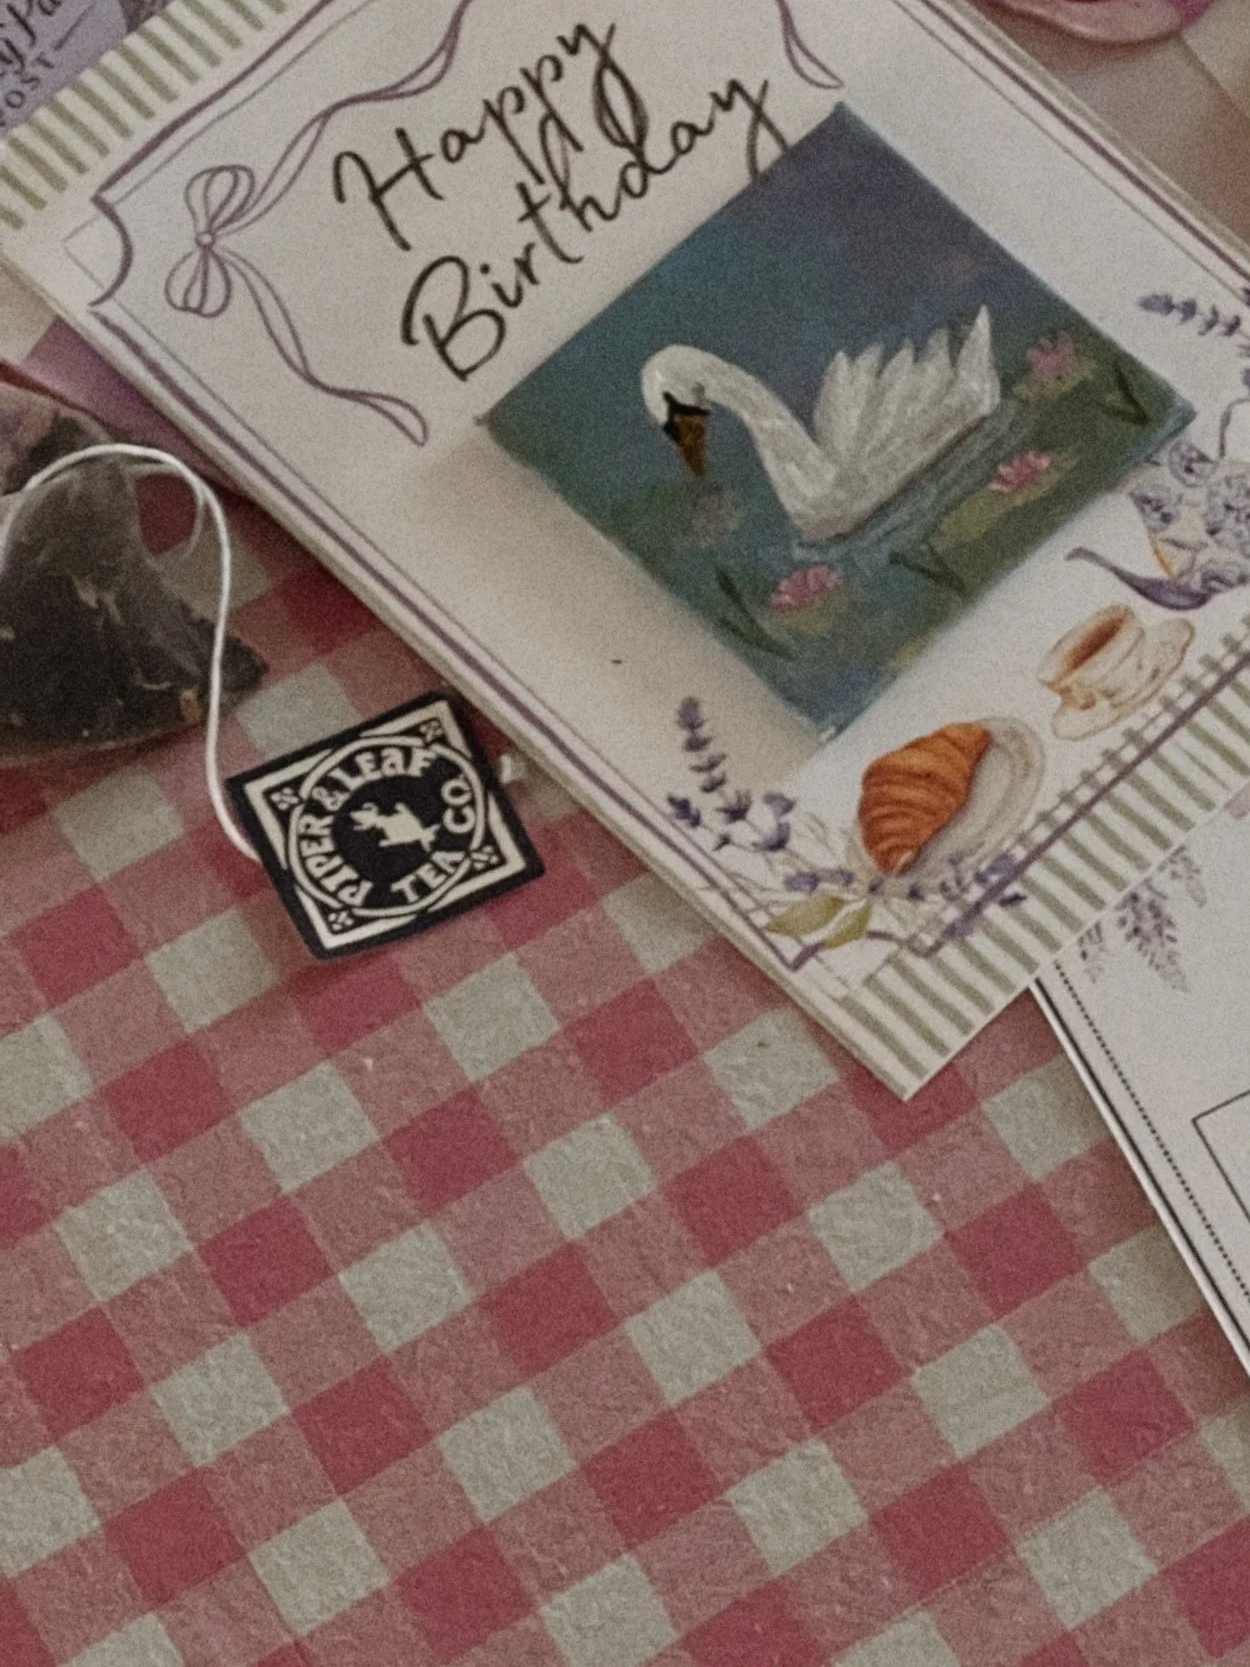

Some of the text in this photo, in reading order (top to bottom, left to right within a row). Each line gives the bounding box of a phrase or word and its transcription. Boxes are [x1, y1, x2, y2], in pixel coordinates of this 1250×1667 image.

[332, 22, 648, 252] Happy
[401, 78, 790, 381] Birthday
[311, 786, 350, 812] &
[300, 814, 373, 908] PIPER
[391, 850, 467, 904] TEA
